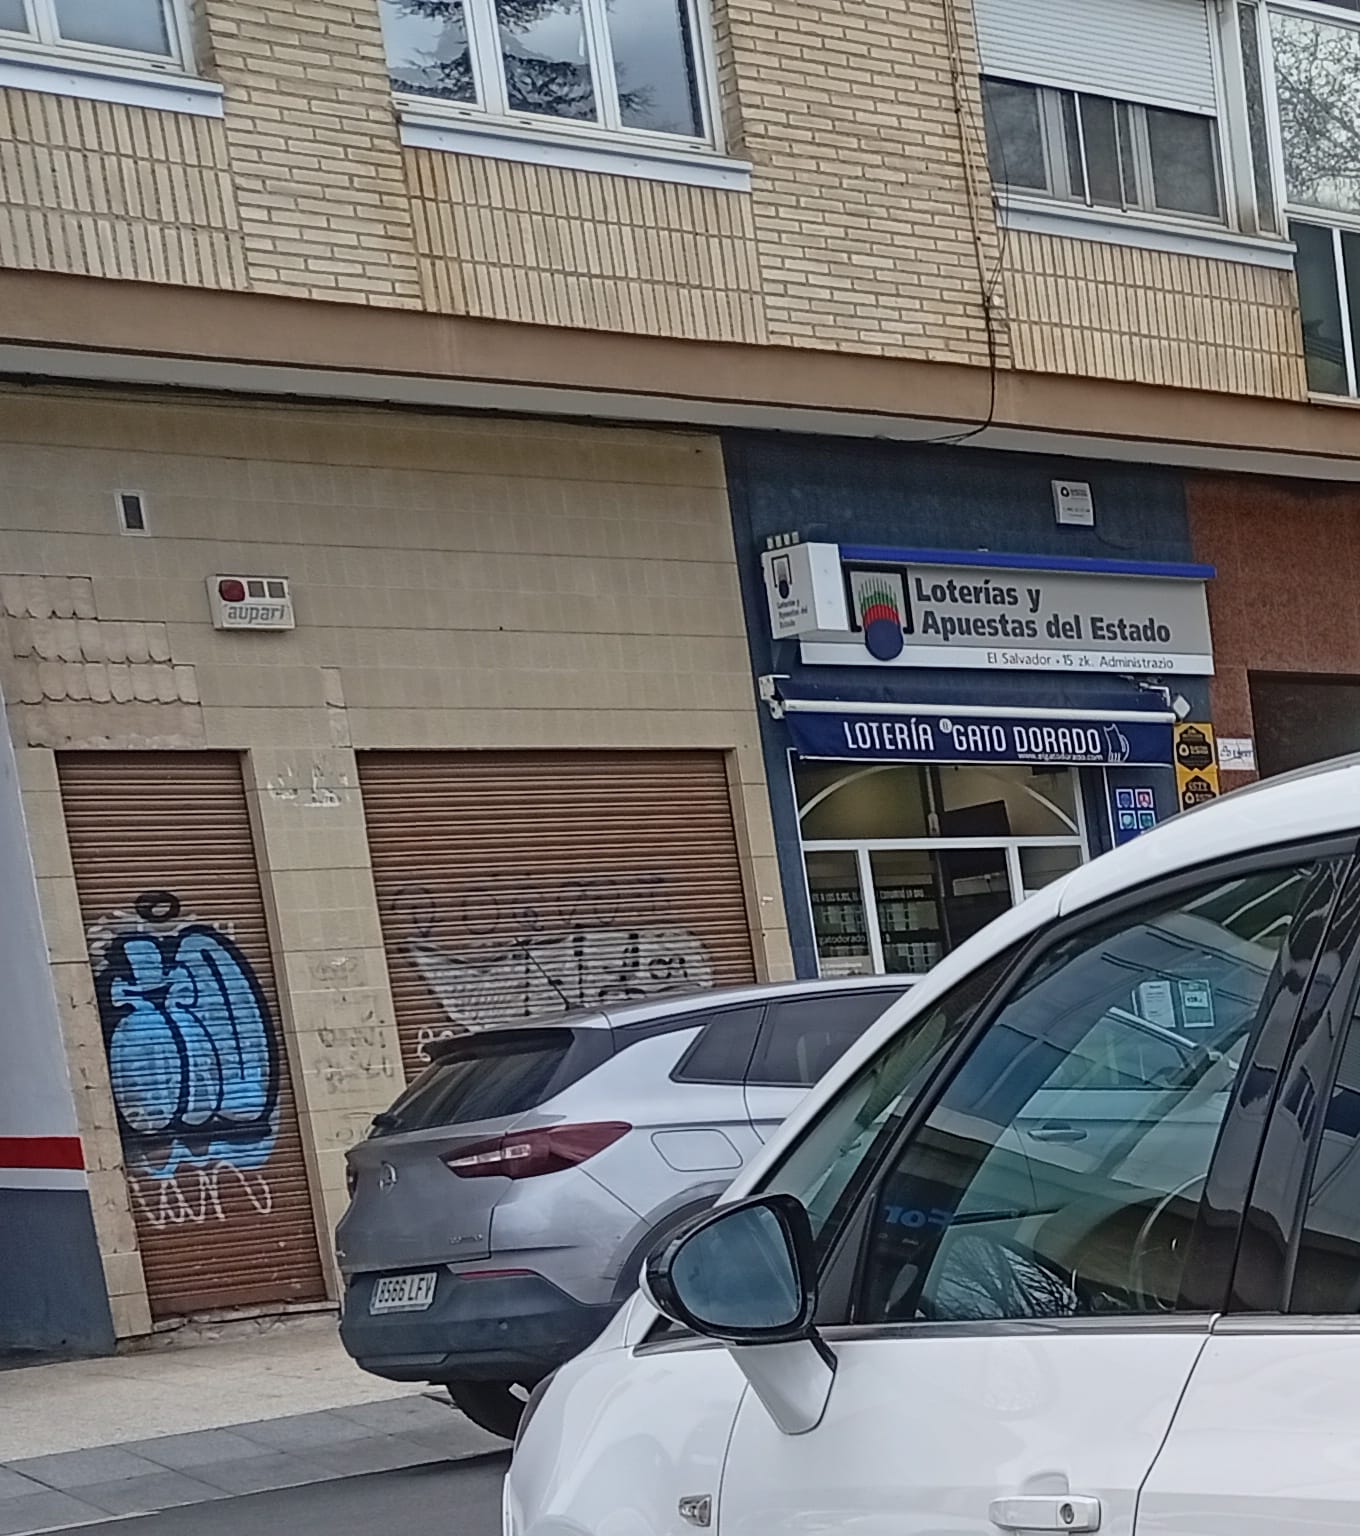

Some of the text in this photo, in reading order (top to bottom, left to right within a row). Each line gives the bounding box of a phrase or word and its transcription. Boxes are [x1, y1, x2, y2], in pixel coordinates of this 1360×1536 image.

[914, 577, 1041, 613] Loterías y
[227, 604, 285, 624] aupari
[921, 610, 1171, 643] Apuestas del Estado
[986, 651, 1174, 670] El Salvador 15 zk. Administrazio
[842, 718, 1102, 755] LOTERÍA GATO DORADO
[407, 1275, 434, 1301] LFY
